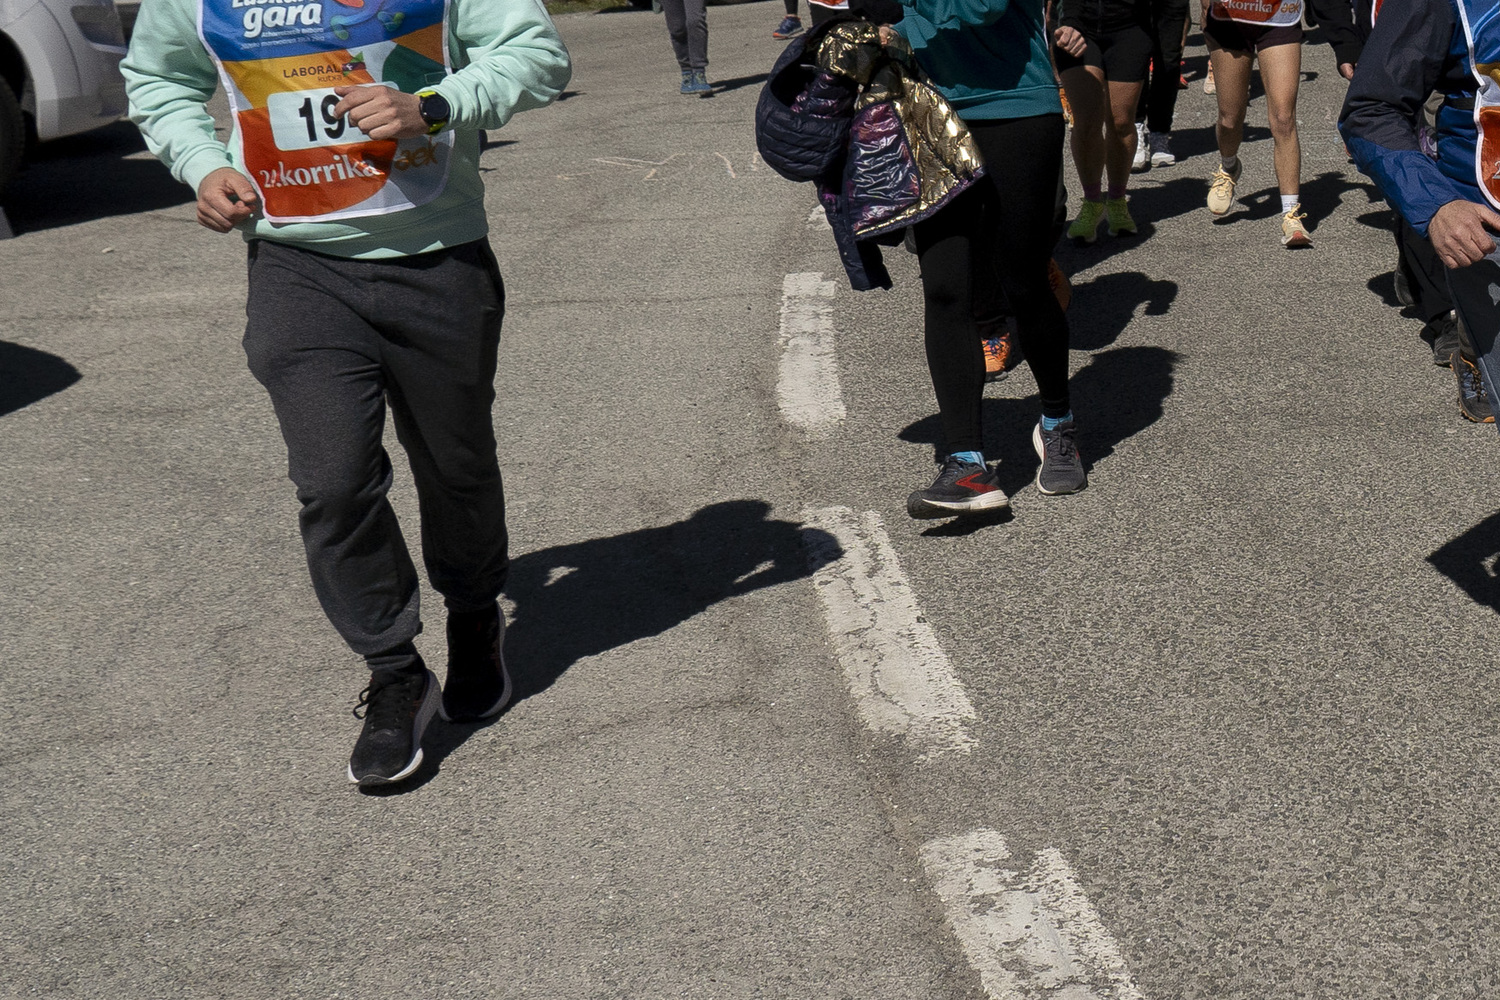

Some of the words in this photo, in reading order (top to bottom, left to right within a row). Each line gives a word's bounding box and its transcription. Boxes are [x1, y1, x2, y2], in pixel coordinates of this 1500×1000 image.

[243, 3, 322, 38] gara
[1281, 2, 1300, 14] aek
[283, 63, 342, 78] LABORAL
[317, 74, 342, 82] kutxa
[299, 94, 369, 142] 19
[394, 136, 438, 171] aek
